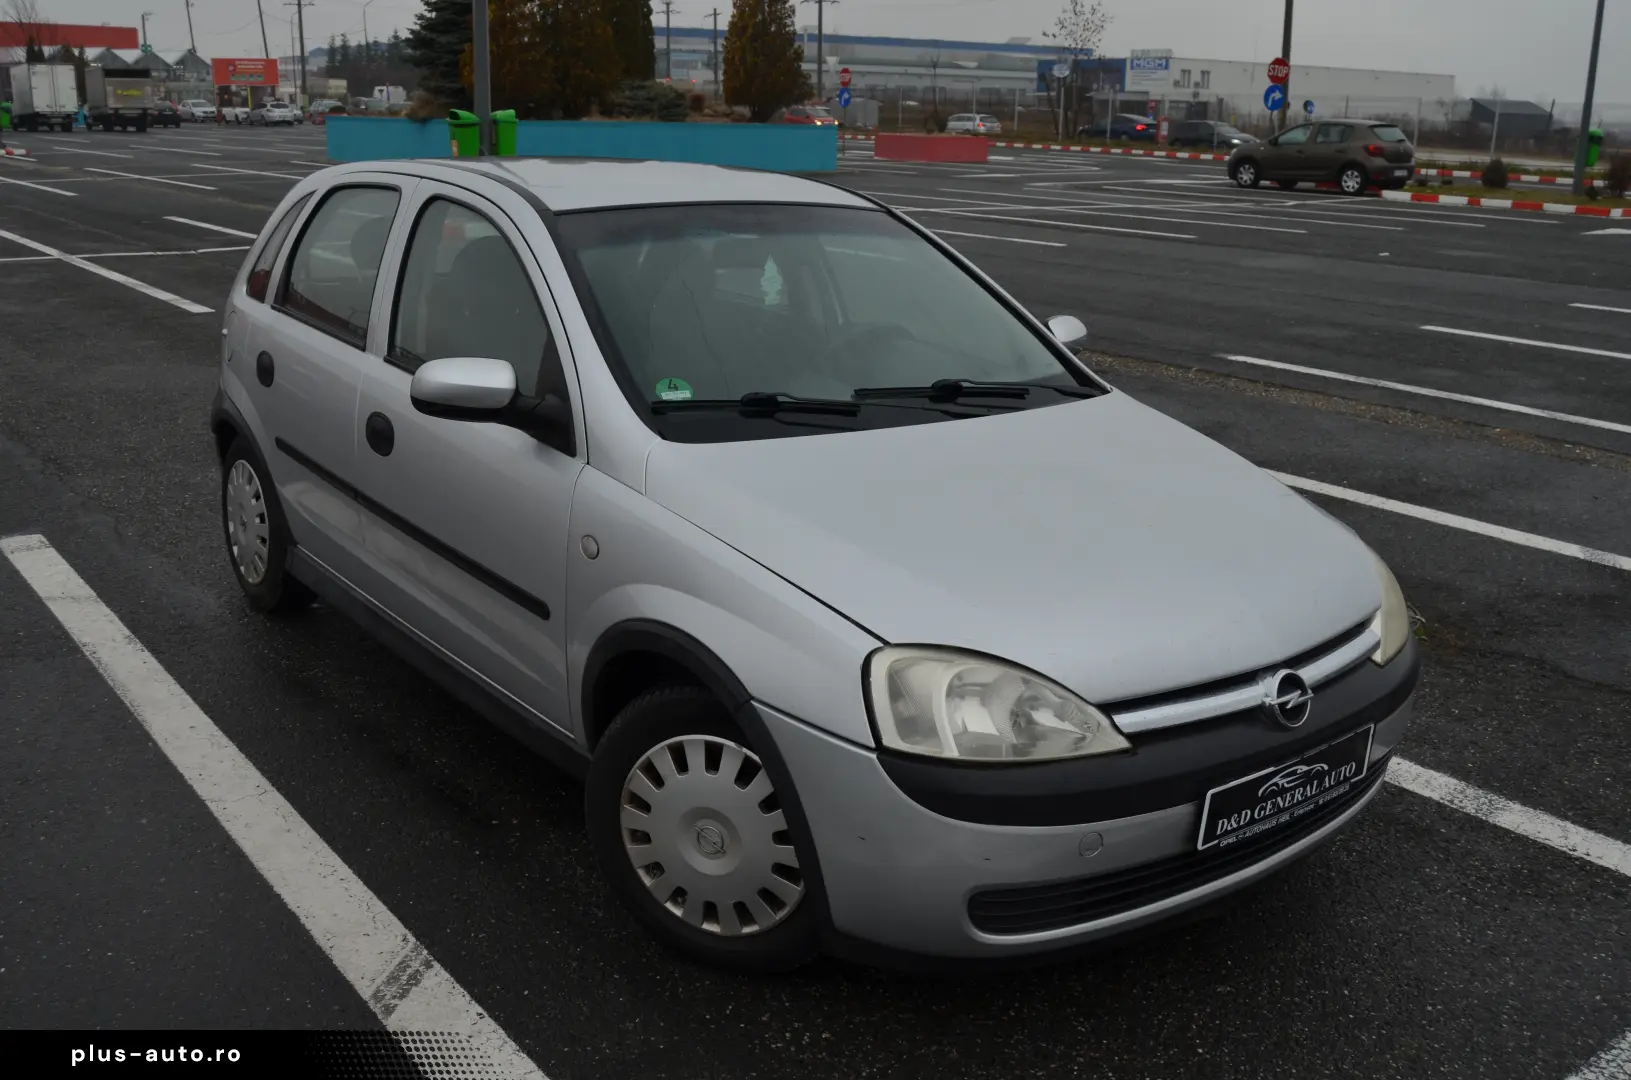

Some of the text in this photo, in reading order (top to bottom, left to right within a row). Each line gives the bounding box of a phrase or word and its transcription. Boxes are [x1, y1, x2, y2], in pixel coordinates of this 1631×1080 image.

[1133, 58, 1166, 69] MGM
[1268, 65, 1289, 78] STOP
[668, 378, 679, 391] 4
[1216, 809, 1251, 835] D&D
[1254, 780, 1320, 819] GENERAL
[1321, 762, 1356, 790] AUTO
